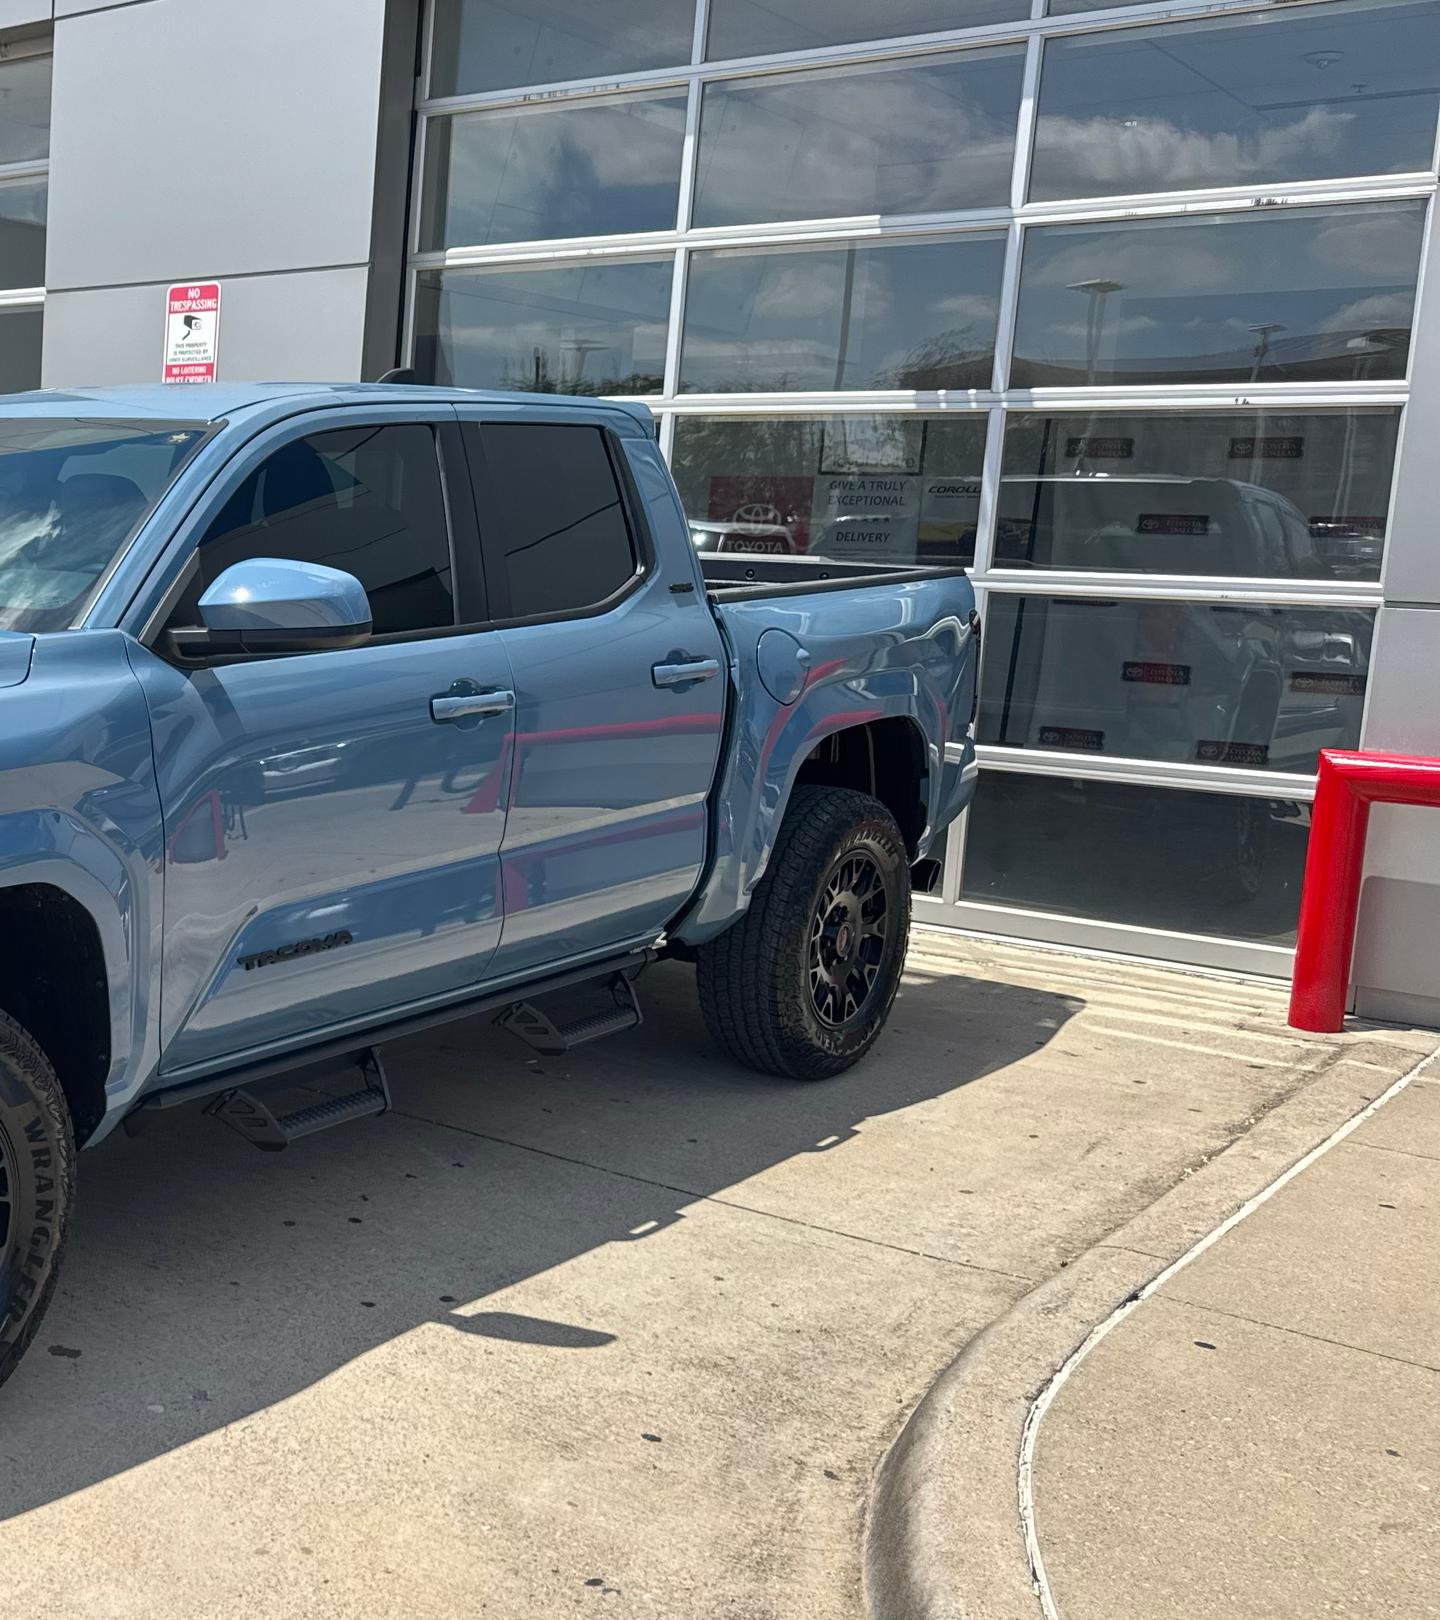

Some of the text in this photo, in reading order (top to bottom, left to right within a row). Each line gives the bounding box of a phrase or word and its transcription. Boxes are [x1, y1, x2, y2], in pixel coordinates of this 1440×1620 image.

[187, 288, 201, 299] NO
[170, 299, 217, 312] TRESPASSING
[829, 480, 906, 491] GIVE A TRULY
[928, 486, 982, 494] COROLL
[827, 495, 905, 506] EXCEPTIONAL
[836, 531, 891, 543] DELIVERY
[726, 540, 784, 553] TOYOTA
[237, 930, 353, 971] TACOMA
[4, 1114, 55, 1332] WRANGLER
